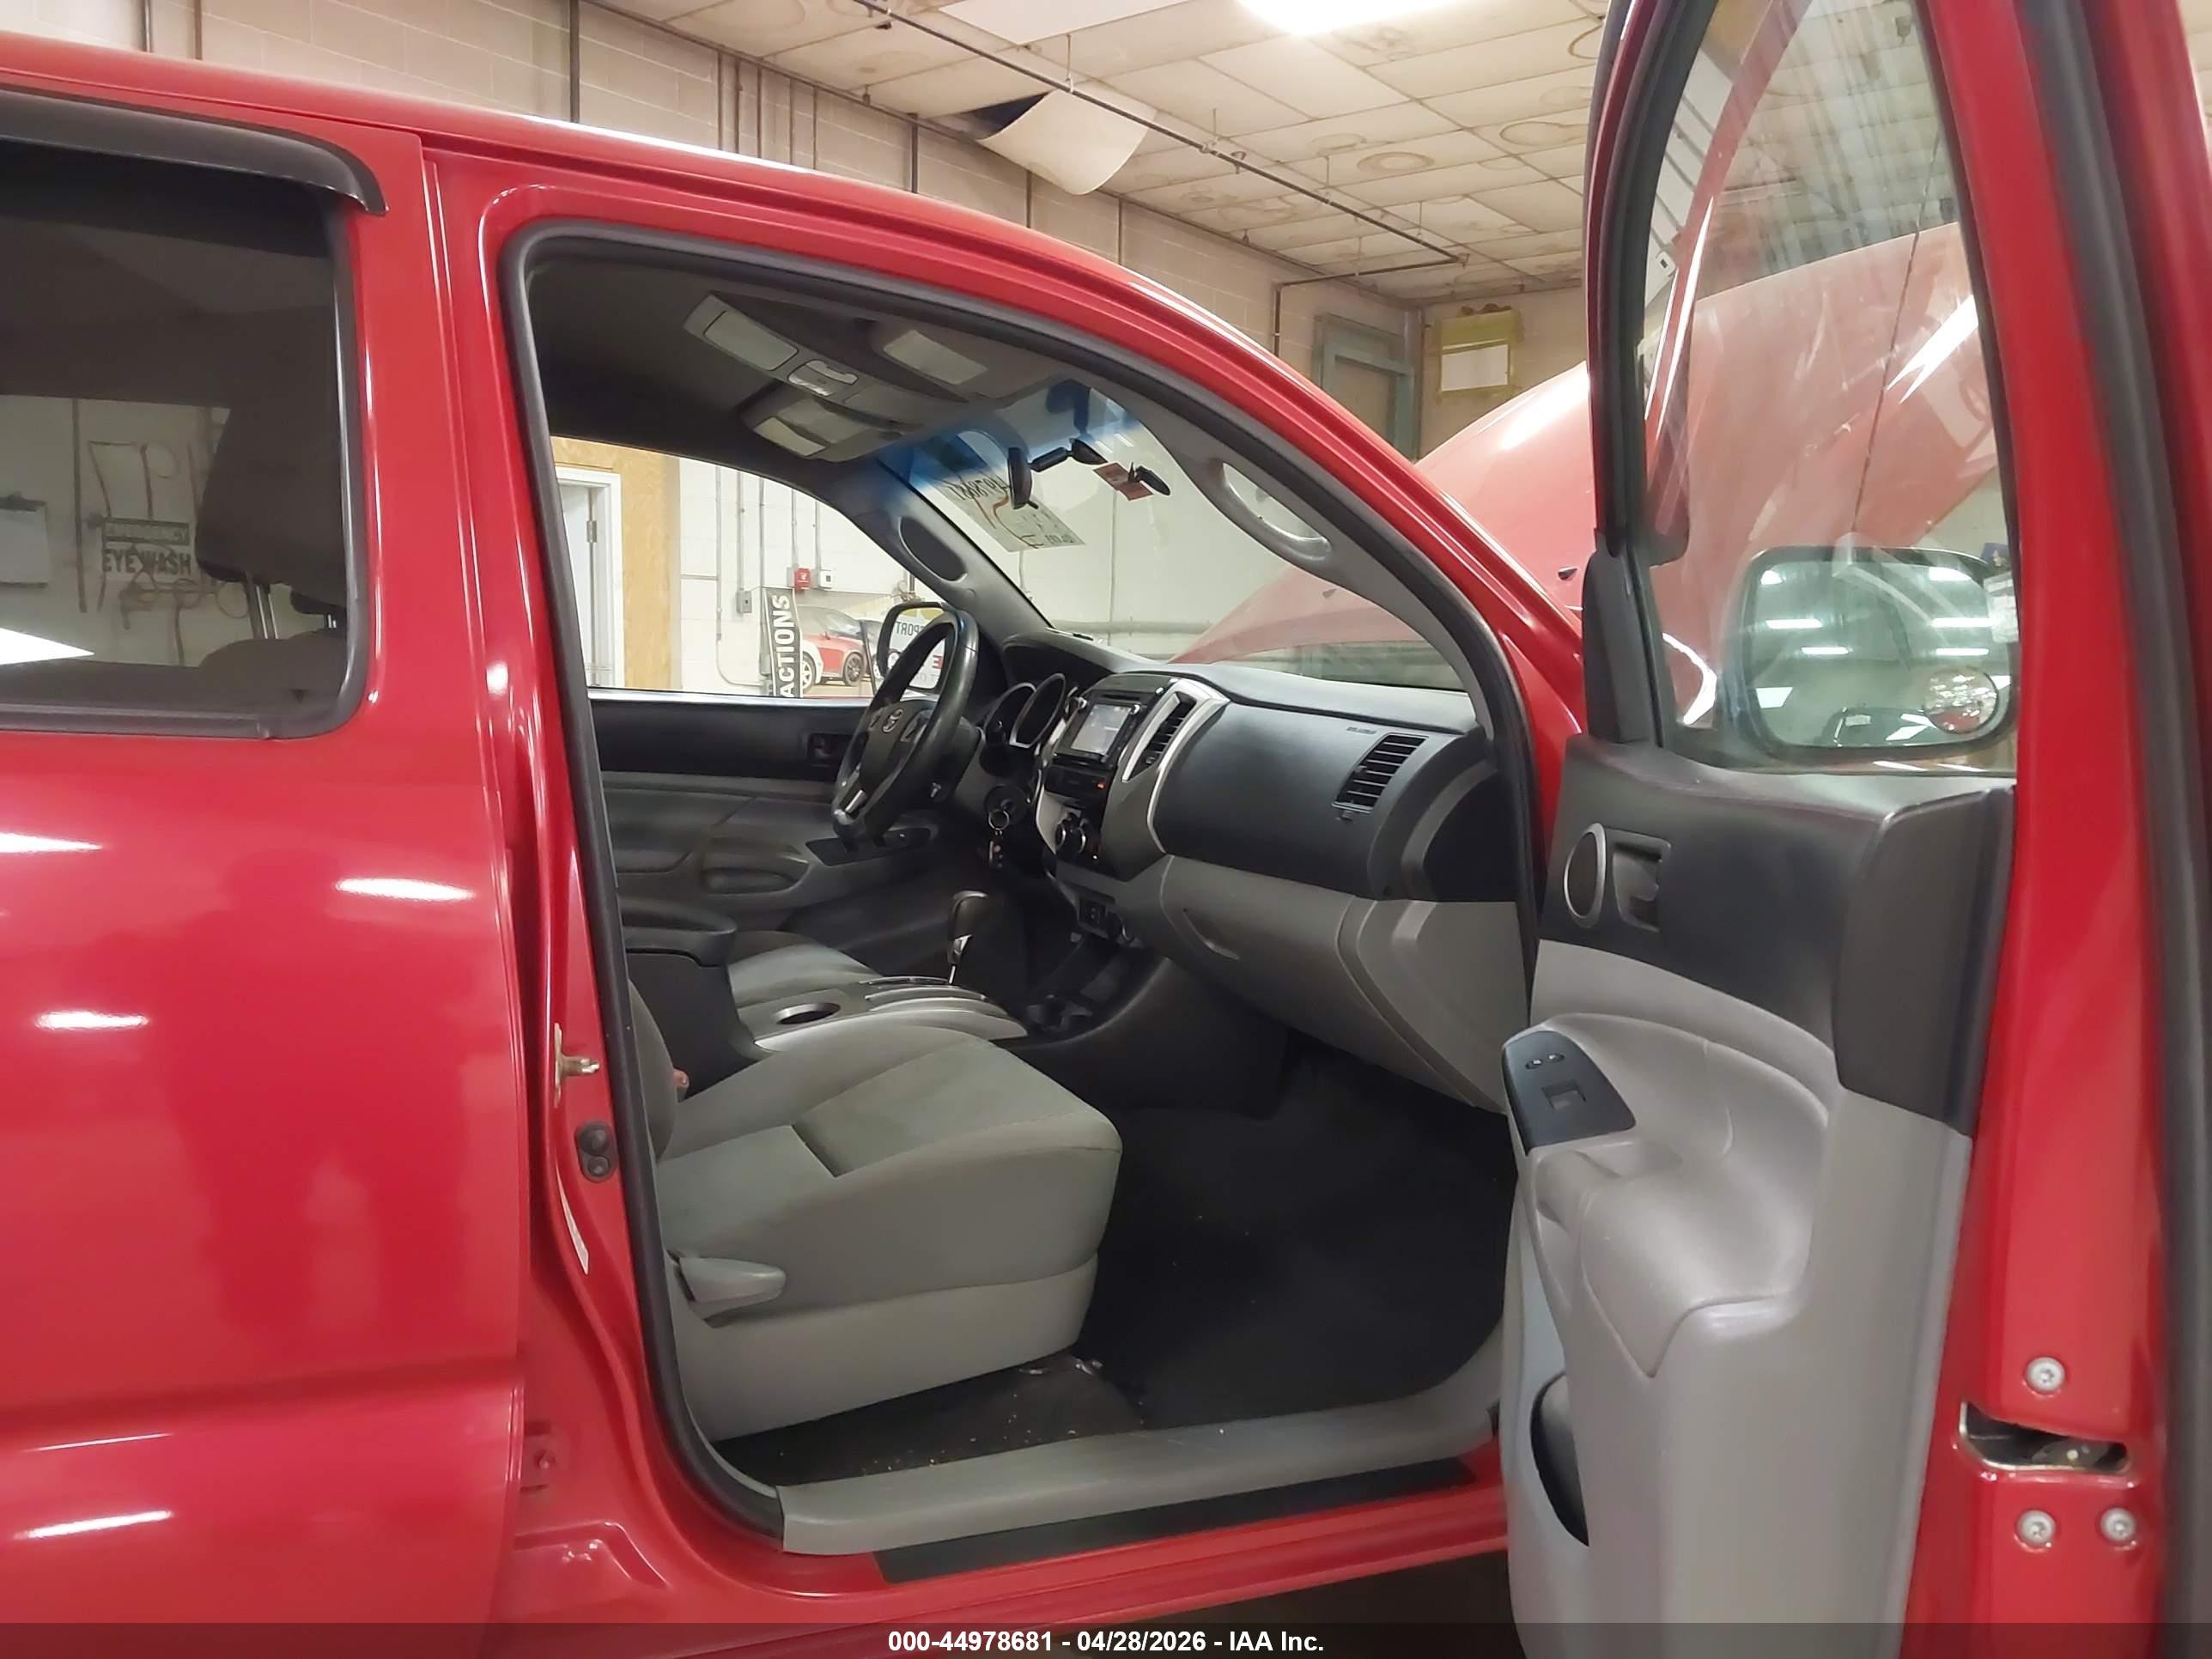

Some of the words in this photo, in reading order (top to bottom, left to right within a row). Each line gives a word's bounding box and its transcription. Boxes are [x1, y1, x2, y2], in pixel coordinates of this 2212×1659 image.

[103, 548, 137, 574] EYE
[139, 550, 191, 576] WASH
[772, 593, 795, 698] ACTIONS
